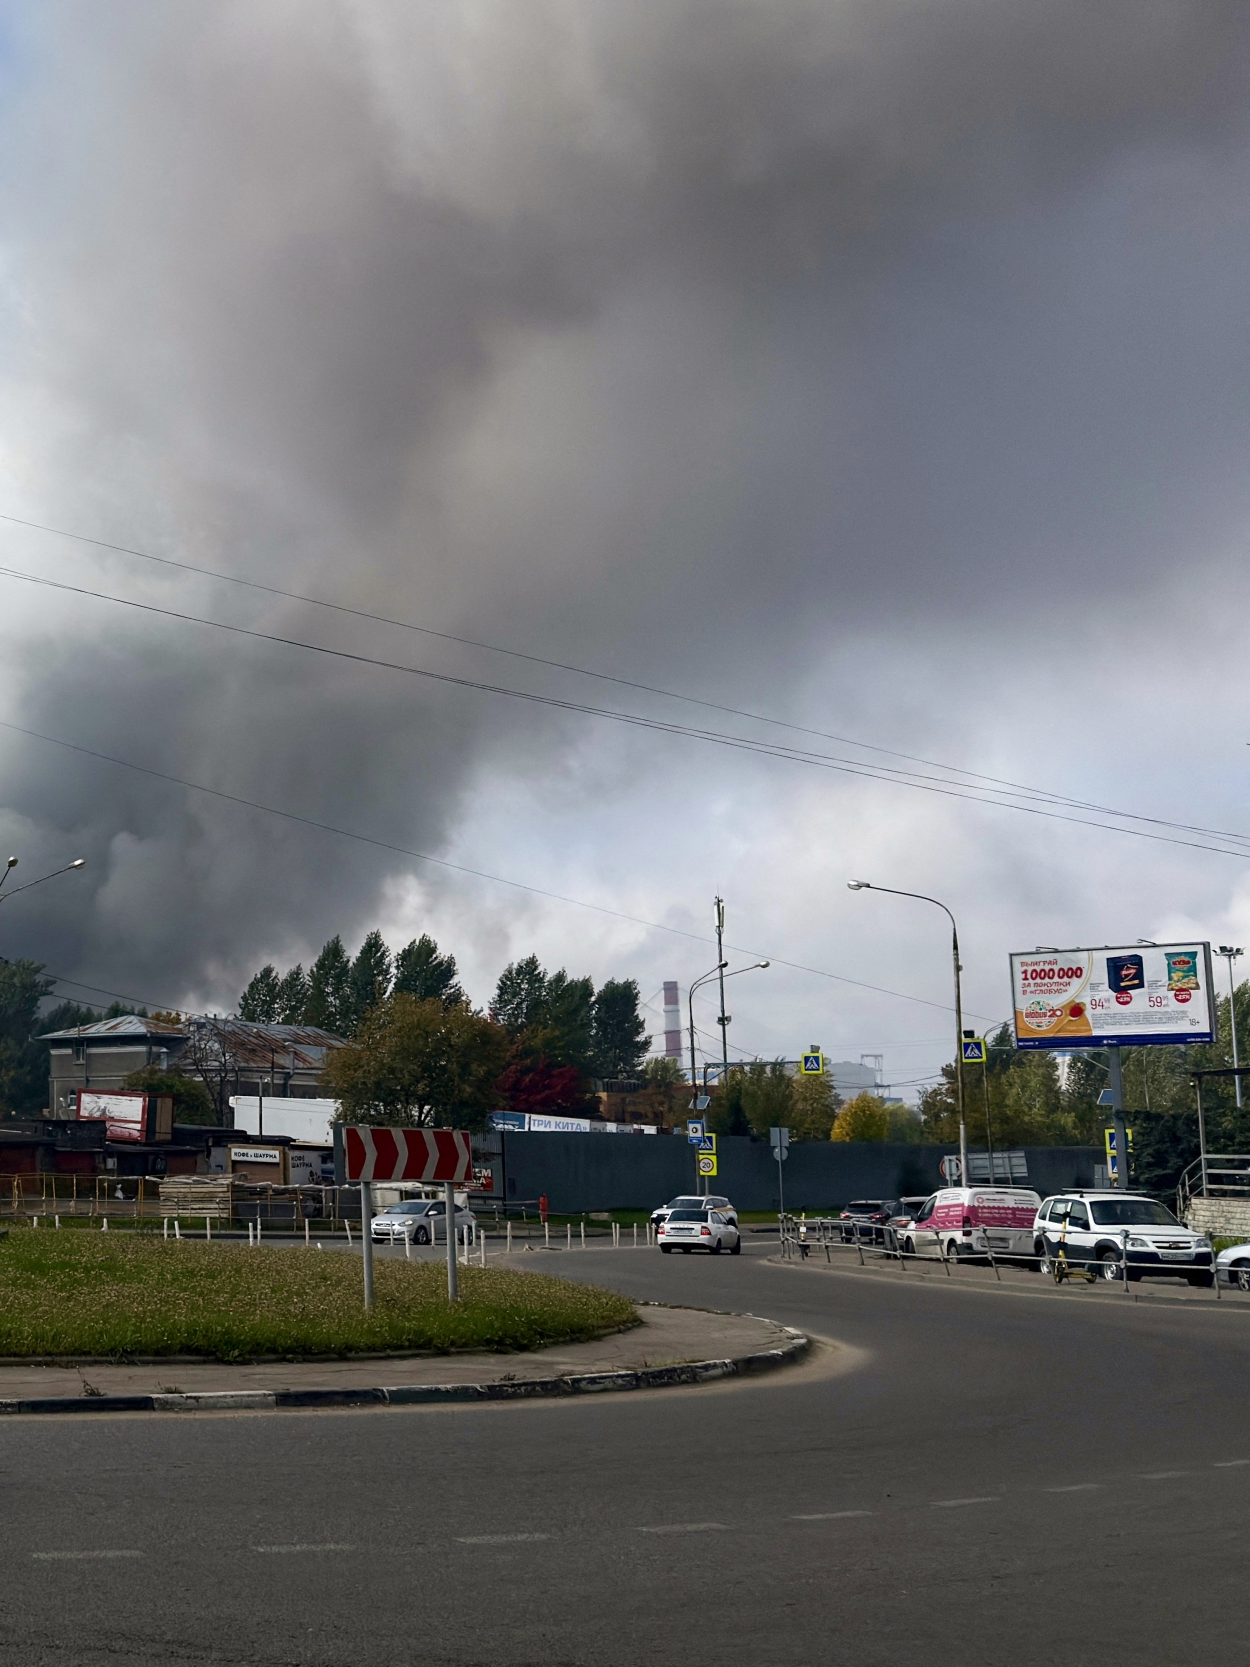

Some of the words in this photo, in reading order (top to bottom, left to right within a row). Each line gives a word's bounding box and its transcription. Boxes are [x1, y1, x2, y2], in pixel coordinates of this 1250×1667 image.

[1020, 959, 1058, 968] ВЫИГРАЙ
[1090, 998, 1104, 1010] 94
[1148, 996, 1163, 1008] 59
[1048, 1008, 1063, 1018] 20
[1189, 1018, 1200, 1026] 18+
[702, 1161, 711, 1169] 20
